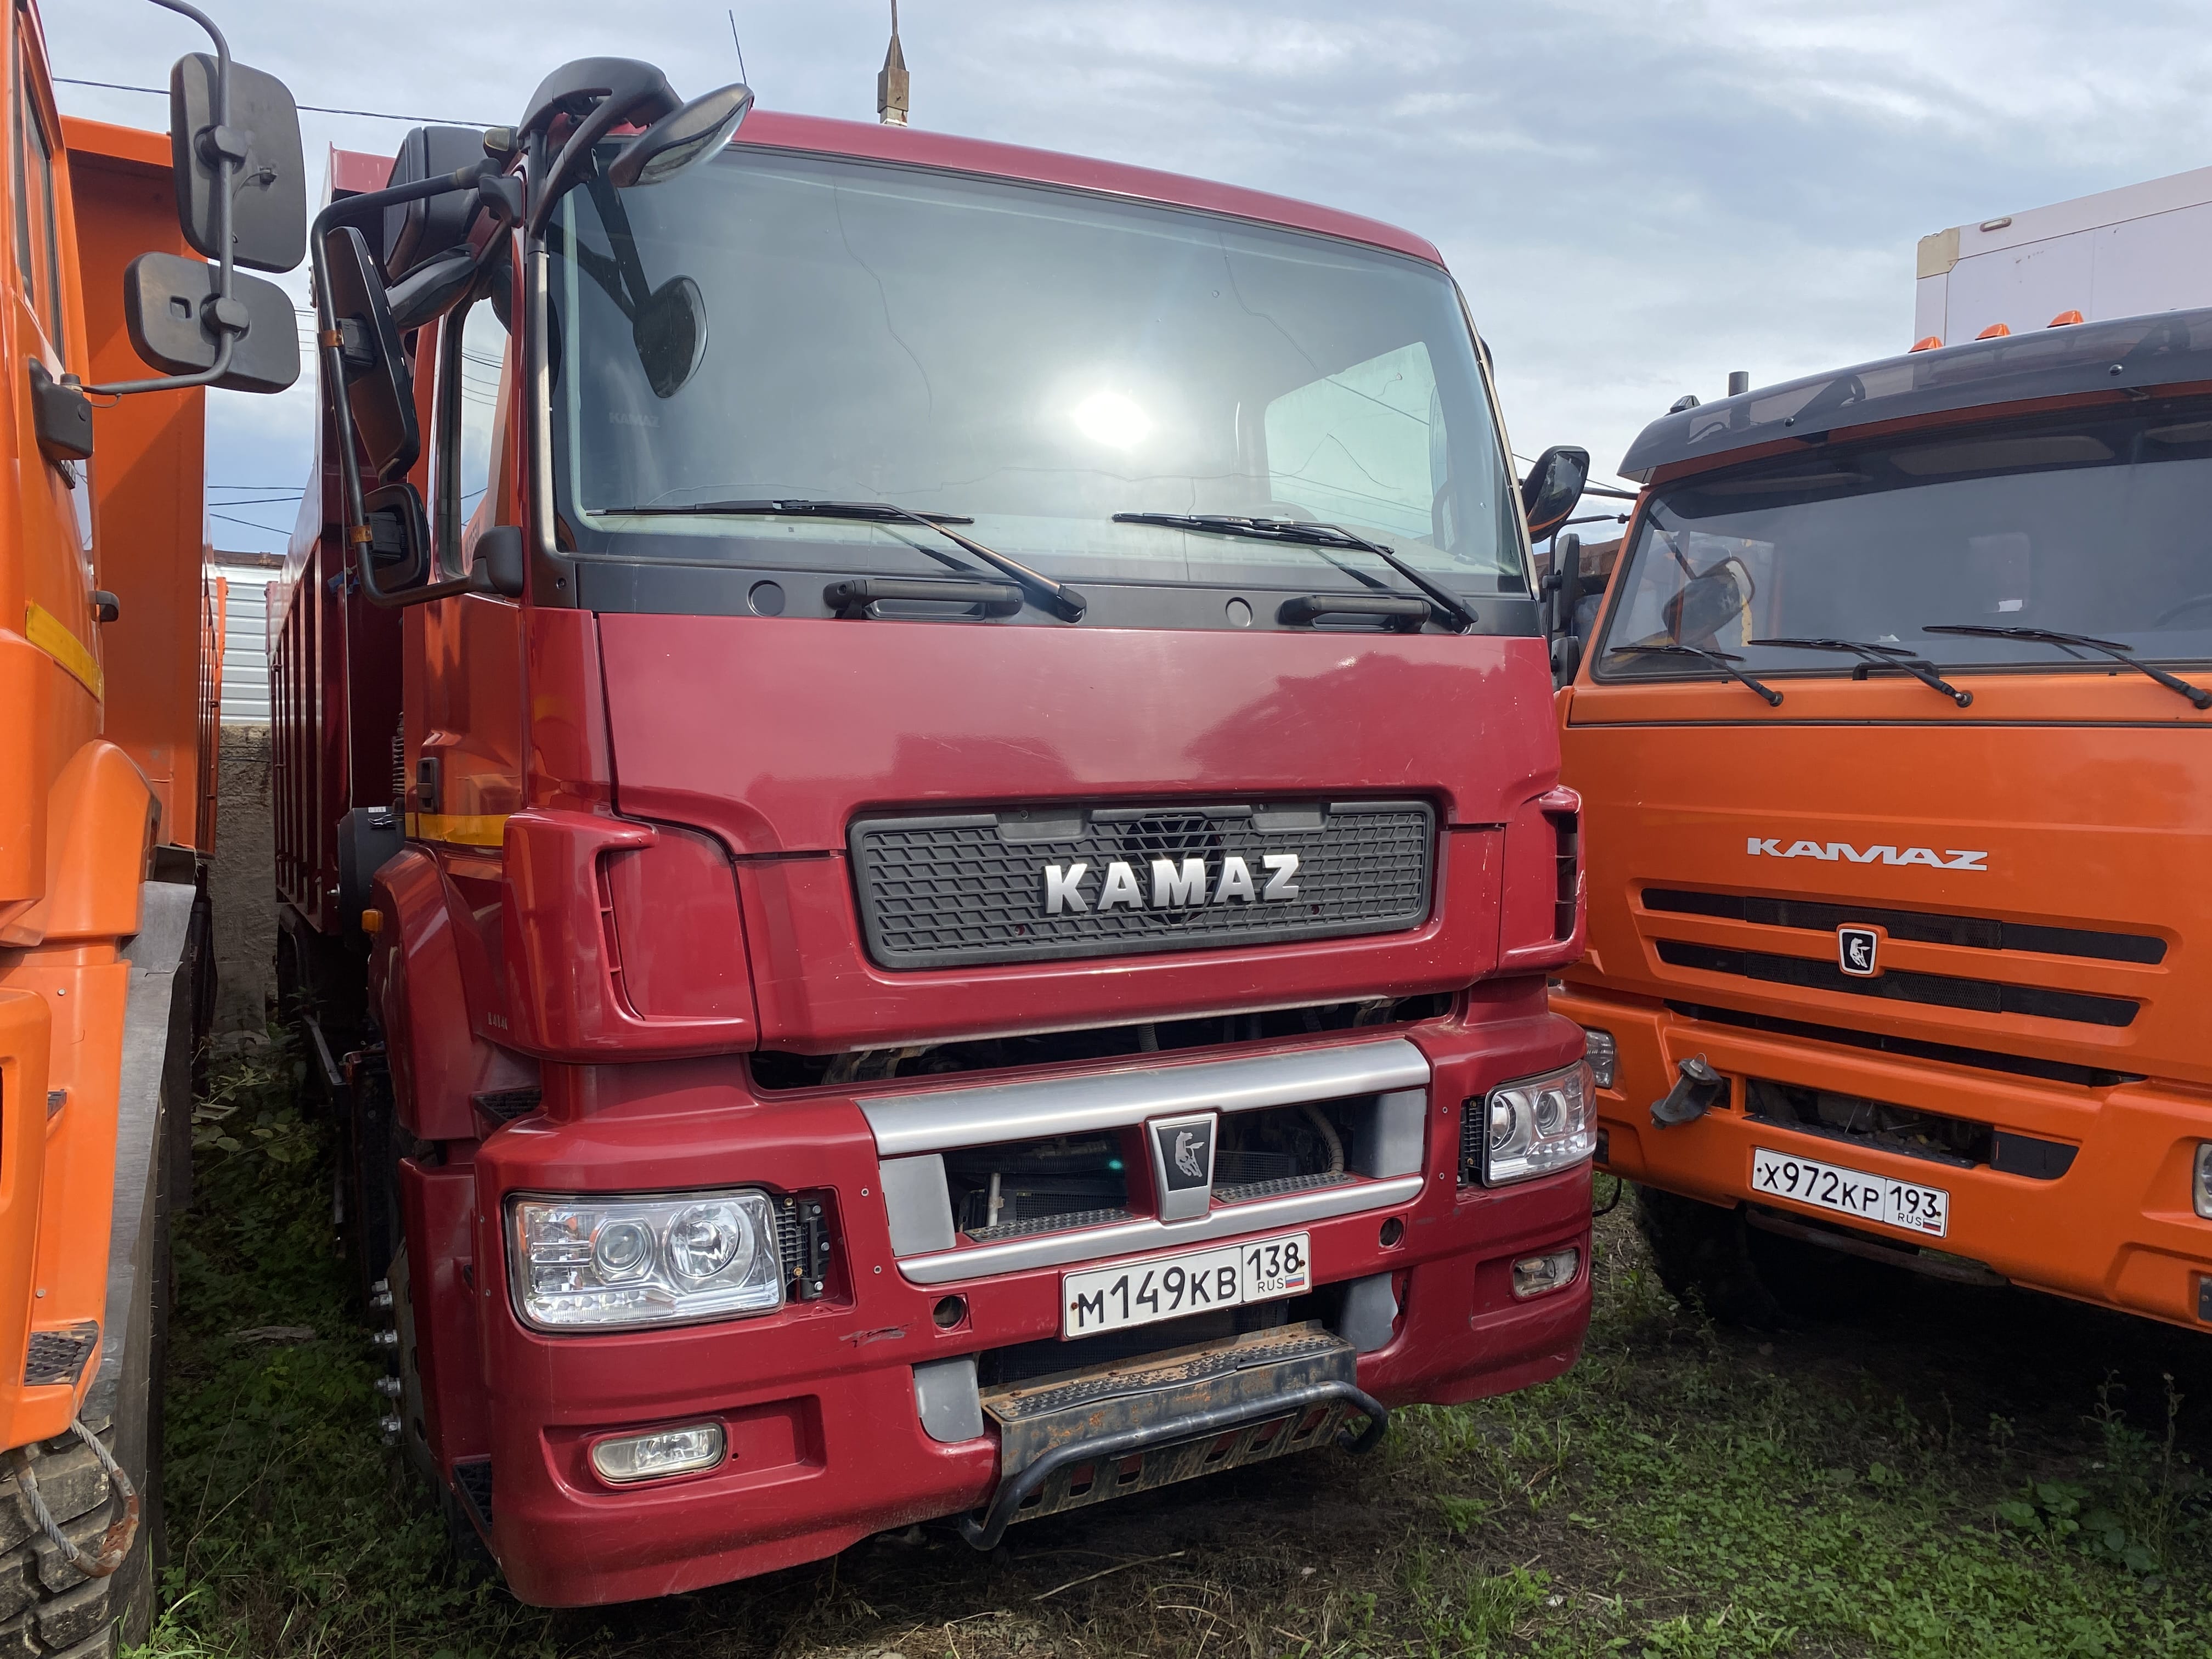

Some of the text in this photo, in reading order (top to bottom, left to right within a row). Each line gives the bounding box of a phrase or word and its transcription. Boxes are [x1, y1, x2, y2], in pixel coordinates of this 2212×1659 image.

[1747, 837, 1988, 871] KAMAZ
[1044, 853, 1299, 913] KAMAZ
[1889, 1186, 1938, 1218] 193
[1898, 1212, 1922, 1227] RUS
[1246, 1242, 1299, 1281] 138
[1257, 1277, 1284, 1293] RUS
